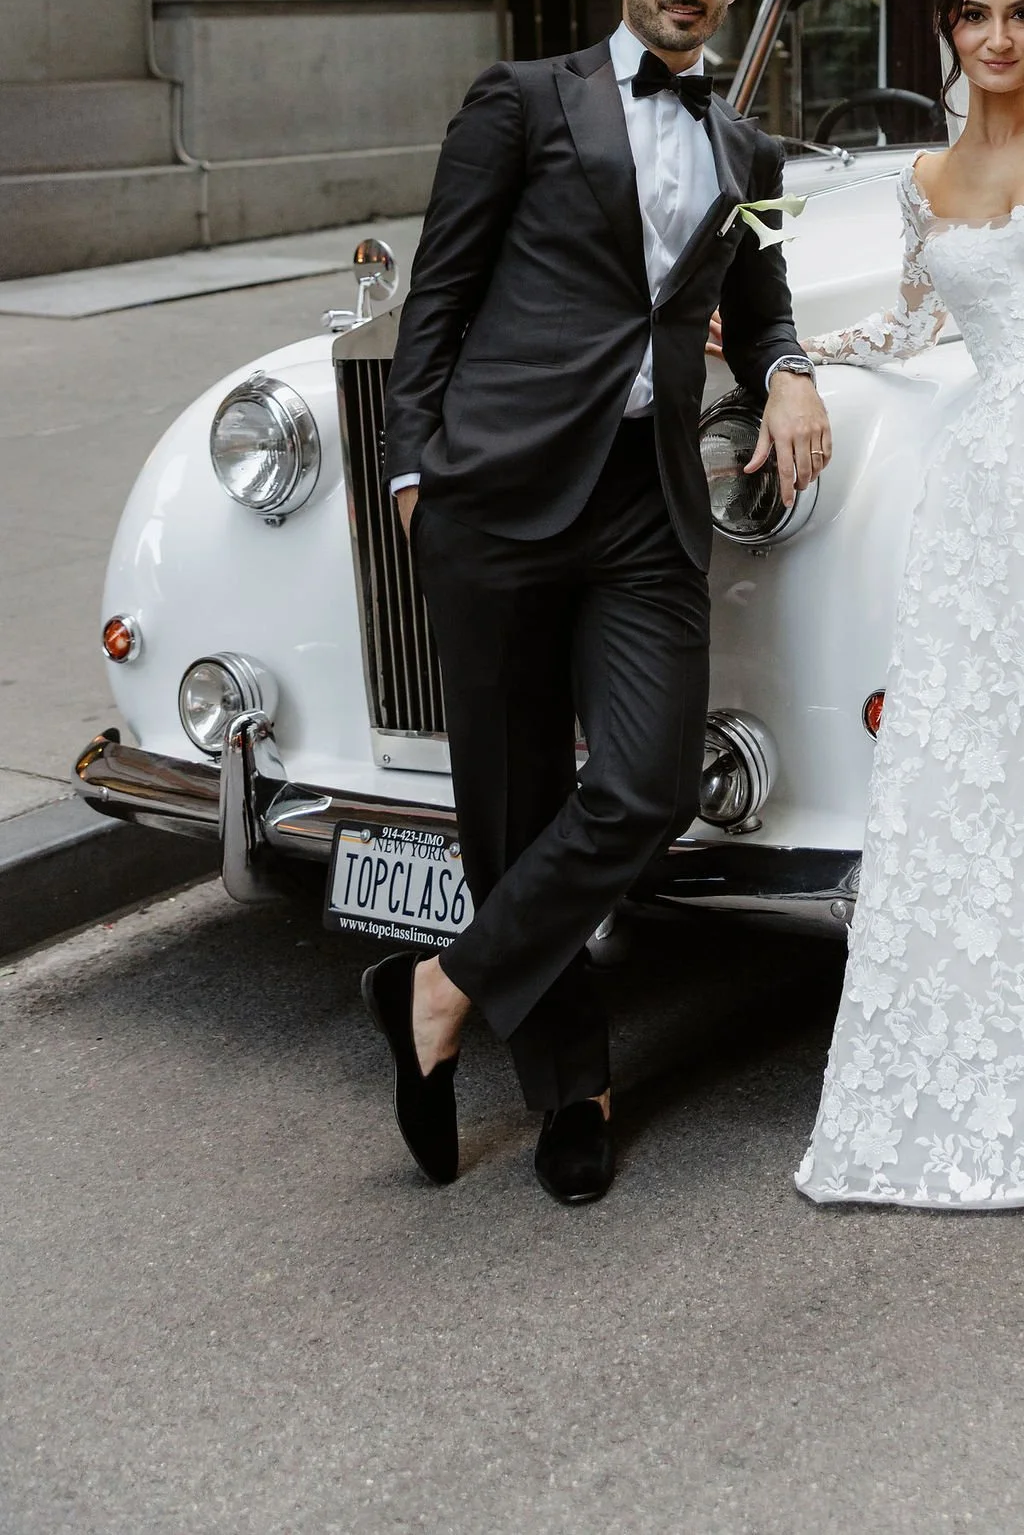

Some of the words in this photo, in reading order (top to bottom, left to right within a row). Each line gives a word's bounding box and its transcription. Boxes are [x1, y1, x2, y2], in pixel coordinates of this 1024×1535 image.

[382, 827, 444, 846] 914-423-LIMO
[373, 838, 405, 855] NEW
[411, 843, 447, 862] YORK
[344, 853, 467, 925] TOPCLAS6
